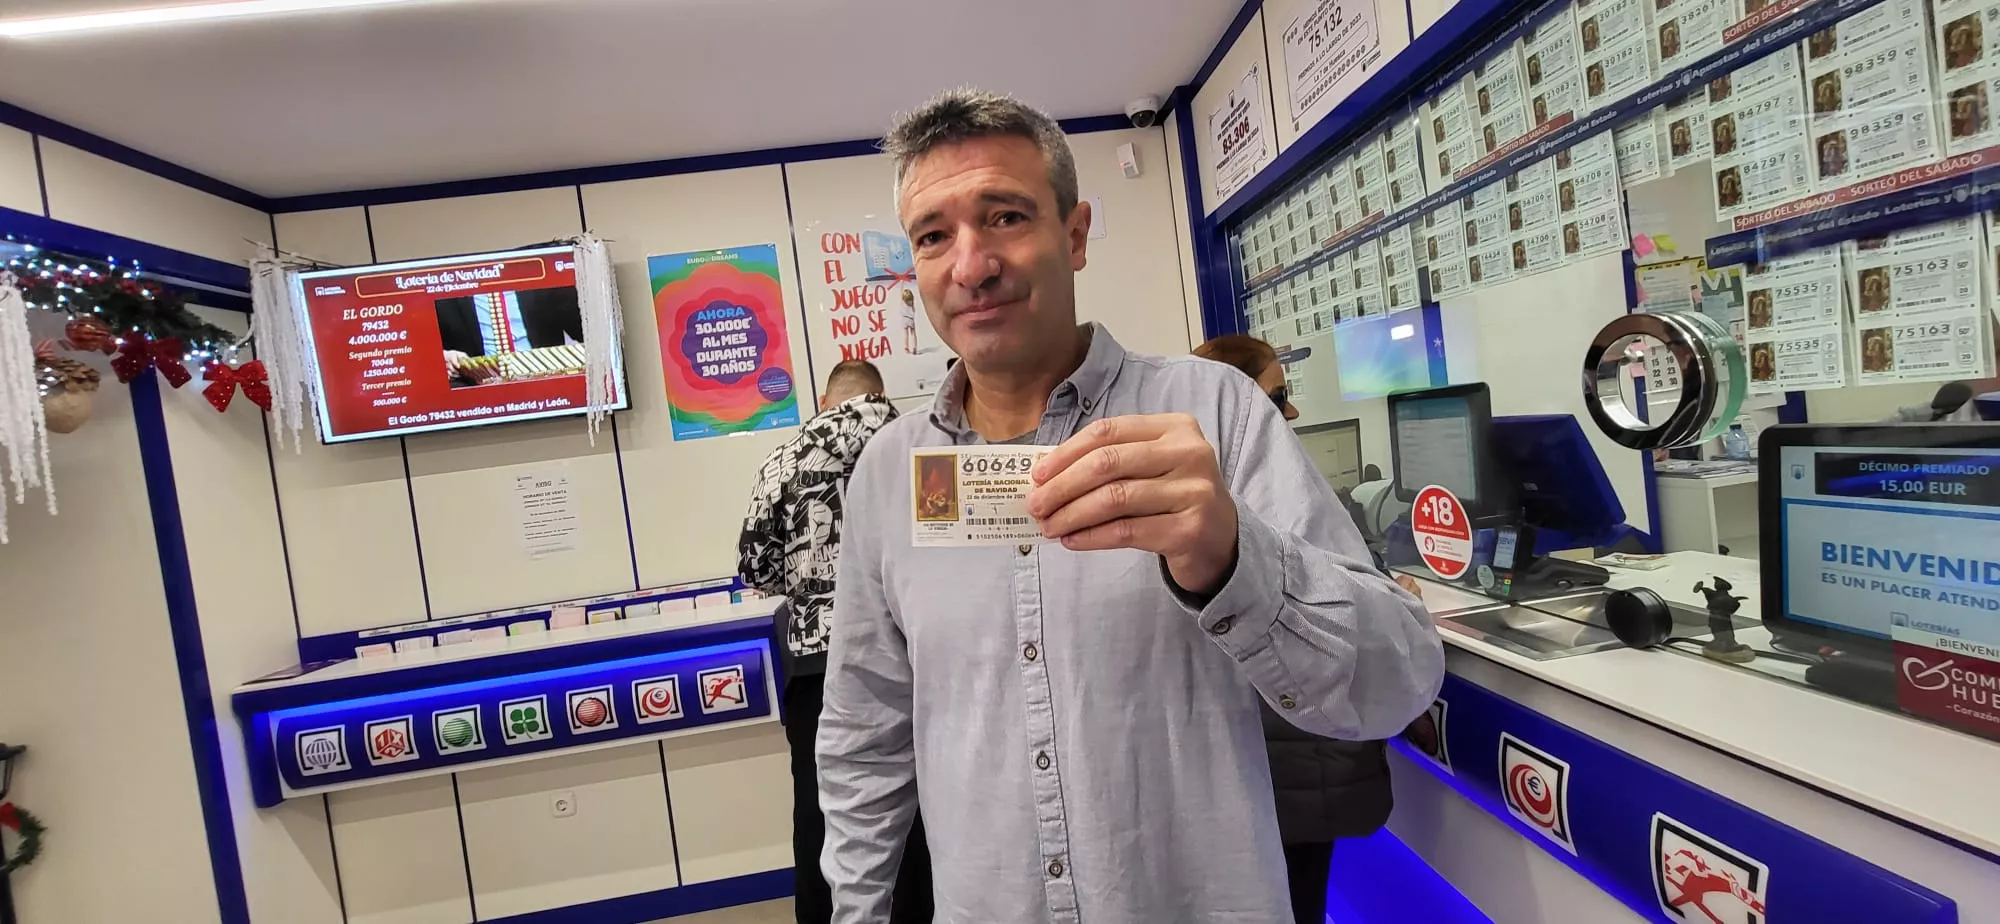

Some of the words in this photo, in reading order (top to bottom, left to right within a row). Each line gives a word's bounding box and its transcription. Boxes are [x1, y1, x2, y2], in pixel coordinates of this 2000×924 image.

[1309, 6, 1342, 53] 75.132
[1724, 15, 1760, 40] SORTEO
[1761, 6, 1779, 20] DEL
[1742, 38, 1760, 54] del
[1763, 19, 1805, 43] Estado
[1844, 49, 1897, 78] 98359
[1738, 97, 1780, 120] 84797
[1223, 116, 1250, 155] 83.306
[1850, 114, 1904, 139] 98359
[1743, 153, 1785, 174] 84797
[1736, 211, 1772, 228] SORTEO
[1773, 205, 1792, 218] DEL
[1850, 175, 1897, 196] SORTEO
[1900, 169, 1922, 184] DEL
[821, 232, 861, 254] CON
[440, 271, 455, 283] de
[455, 263, 505, 281] Navidad
[824, 259, 847, 284] EL
[1893, 259, 1949, 277] 75163
[830, 284, 887, 312] JUEGO
[1776, 283, 1818, 297] 75535
[343, 308, 357, 320] EL
[360, 304, 403, 318] GORDO
[697, 307, 745, 321] AHORA
[362, 320, 389, 331] 79432
[831, 314, 861, 339] NO
[868, 309, 887, 333] SE
[1896, 324, 1950, 338] 75163
[348, 331, 397, 345] 4.000.000
[400, 331, 407, 340] €
[702, 336, 720, 348] AL
[721, 332, 748, 346] MES
[1778, 340, 1820, 352] 75535
[348, 348, 382, 361] Segundo
[384, 346, 412, 358] premio
[696, 345, 757, 363] DURANTE
[838, 335, 892, 361] JUEGA
[702, 364, 719, 377] 30
[721, 359, 756, 375] AÑOS
[1651, 358, 1660, 366] 15
[1653, 369, 1661, 377] 22
[1667, 366, 1676, 375] 23
[361, 382, 385, 391] Tercer
[386, 379, 412, 390] premio
[1669, 377, 1678, 385] 30
[388, 416, 398, 426] El
[400, 413, 428, 425] Gordo
[429, 410, 455, 421] 79432
[457, 406, 492, 418] vendido
[493, 405, 505, 414] en
[506, 401, 537, 413] Madrid
[546, 398, 571, 408] León.
[963, 458, 1032, 472] 60649
[1859, 460, 1909, 473] DÉCIMO
[1913, 463, 1989, 476] PREMIADO
[1880, 480, 1923, 494] 15.00
[1928, 481, 1967, 496] EUR
[1421, 496, 1454, 526] +18
[1821, 541, 2000, 586] BIENVENID
[1821, 572, 1837, 584] ES
[1842, 574, 1865, 590] UN
[1870, 580, 1931, 601] PLACER
[1937, 591, 2000, 611] ATEND
[1911, 621, 1960, 635] LOTERÍAS
